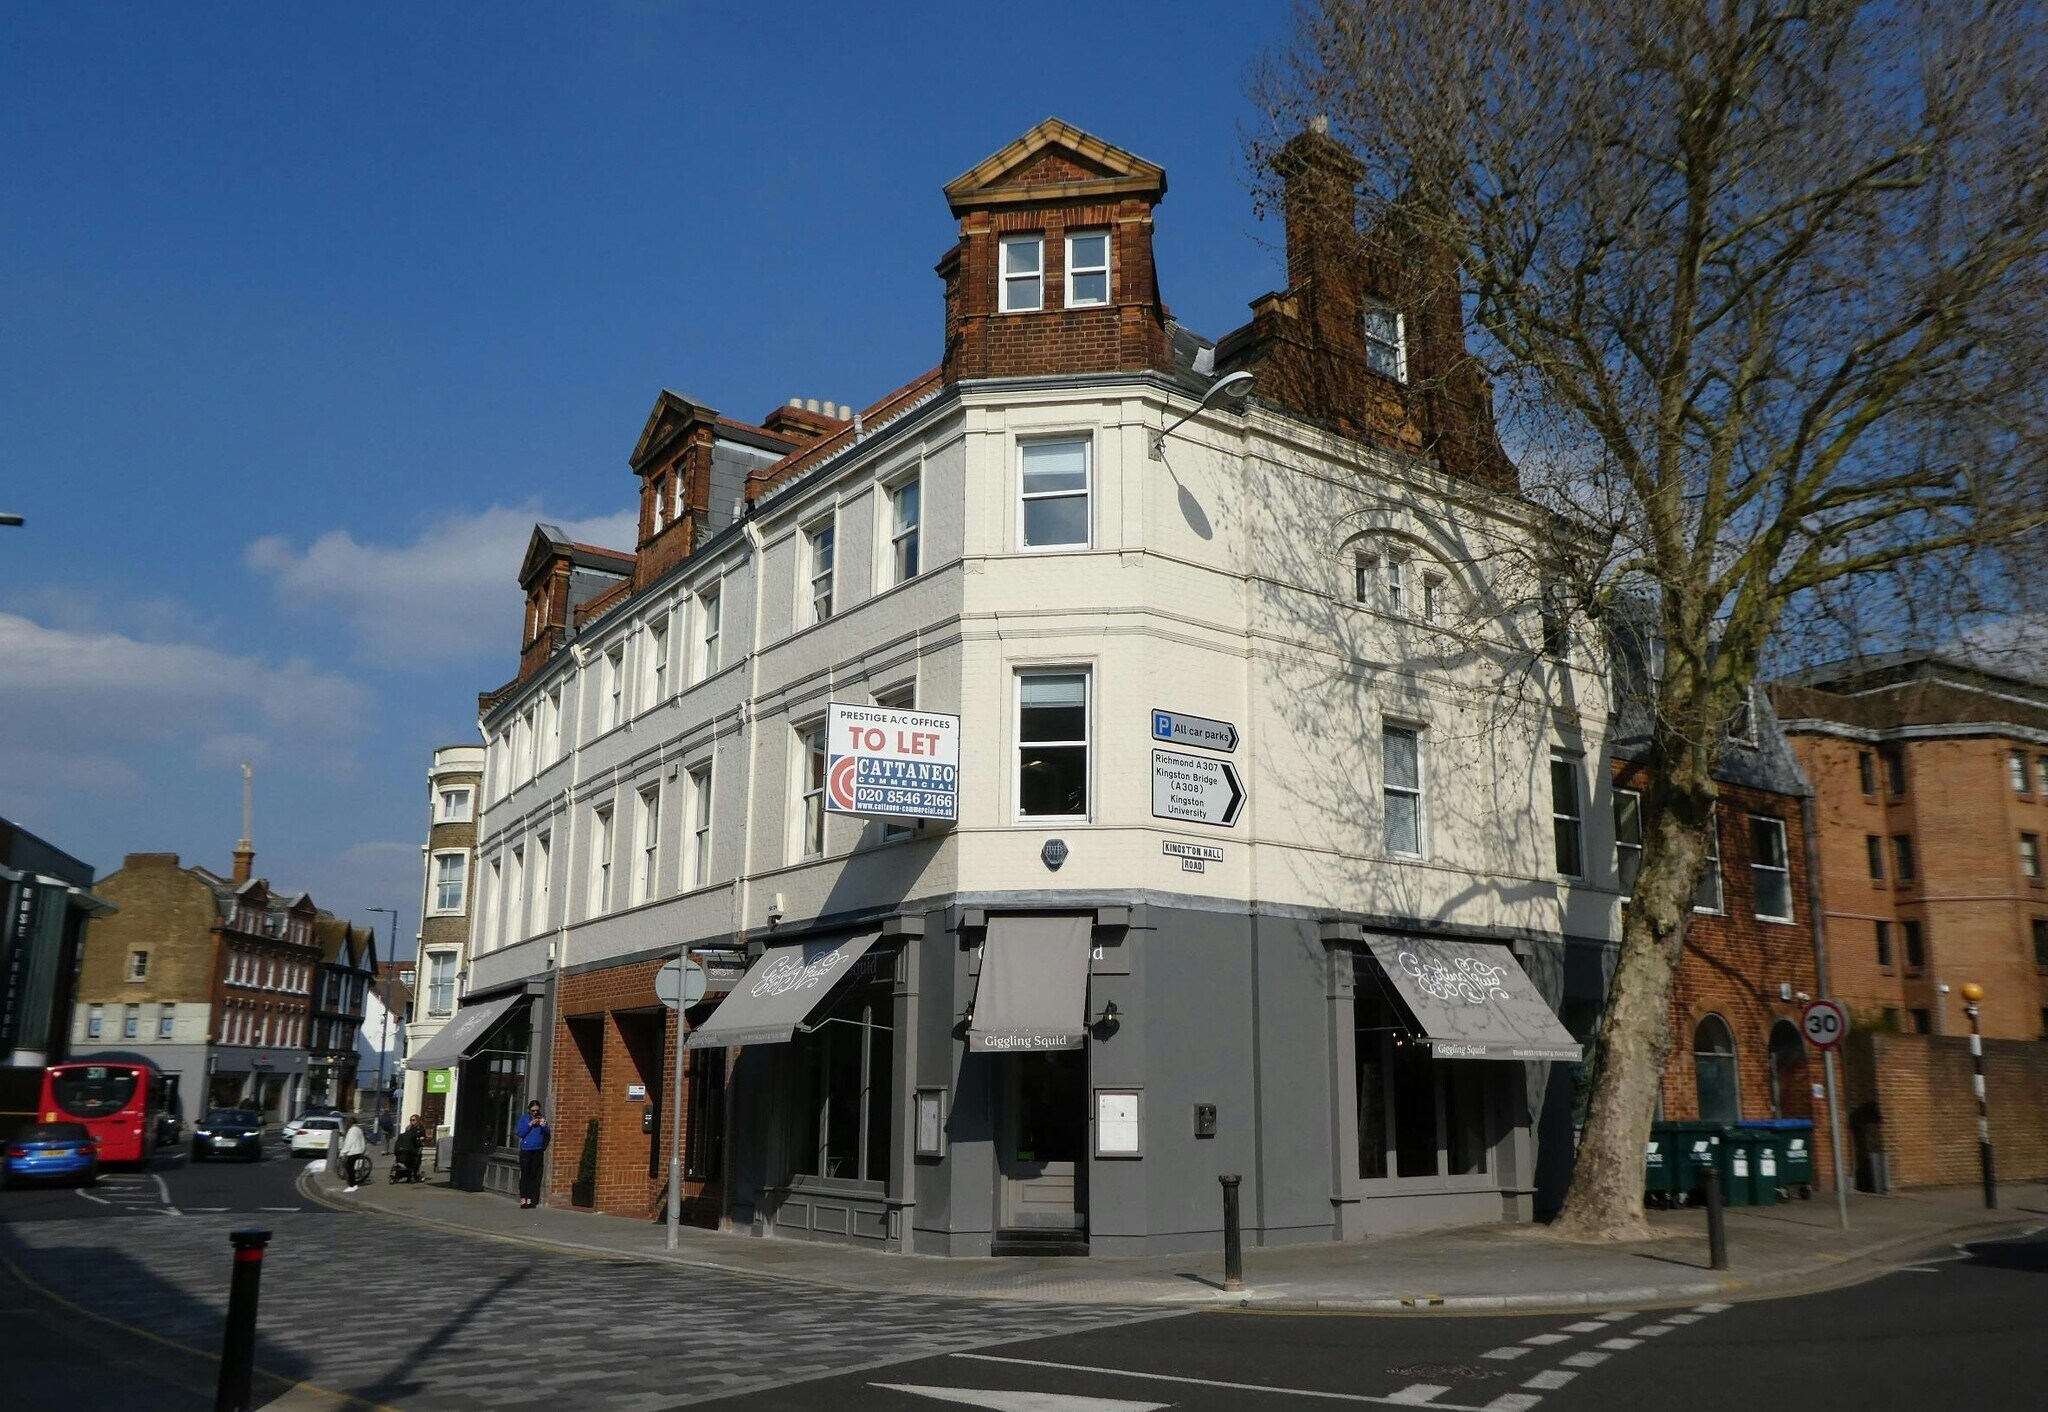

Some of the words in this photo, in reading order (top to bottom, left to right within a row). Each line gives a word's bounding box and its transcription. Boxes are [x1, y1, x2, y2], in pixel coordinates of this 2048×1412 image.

[840, 710, 887, 723] PRESTIGE
[890, 715, 908, 725] A/C
[911, 717, 950, 729] OFFICES
[849, 726, 886, 751] TO
[897, 731, 940, 756] LET
[1174, 723, 1187, 735] All
[1189, 727, 1202, 738] car
[1205, 730, 1229, 742] parks
[858, 758, 954, 782] CATTANEO
[1155, 754, 1194, 768] Richmond
[1196, 761, 1218, 772] A307
[858, 776, 954, 791] COMMERCIAL
[1156, 767, 1190, 782] Kingston
[1193, 773, 1218, 786] Bridge
[1170, 780, 1204, 795] (A308)
[858, 788, 883, 802] 020
[887, 791, 920, 805] 8546
[924, 794, 953, 808] 2166
[1170, 794, 1205, 808] Kingston
[1168, 805, 1207, 819] University
[1165, 843, 1200, 856] KINGSTON
[1203, 848, 1221, 859] HALL
[1184, 859, 1203, 871] ROAD
[1808, 1015, 1838, 1034] 30
[984, 1035, 1031, 1048] Giggling
[1034, 1035, 1067, 1048] Squid
[1437, 1043, 1466, 1057] Giggling
[1466, 1044, 1486, 1057] Squid
